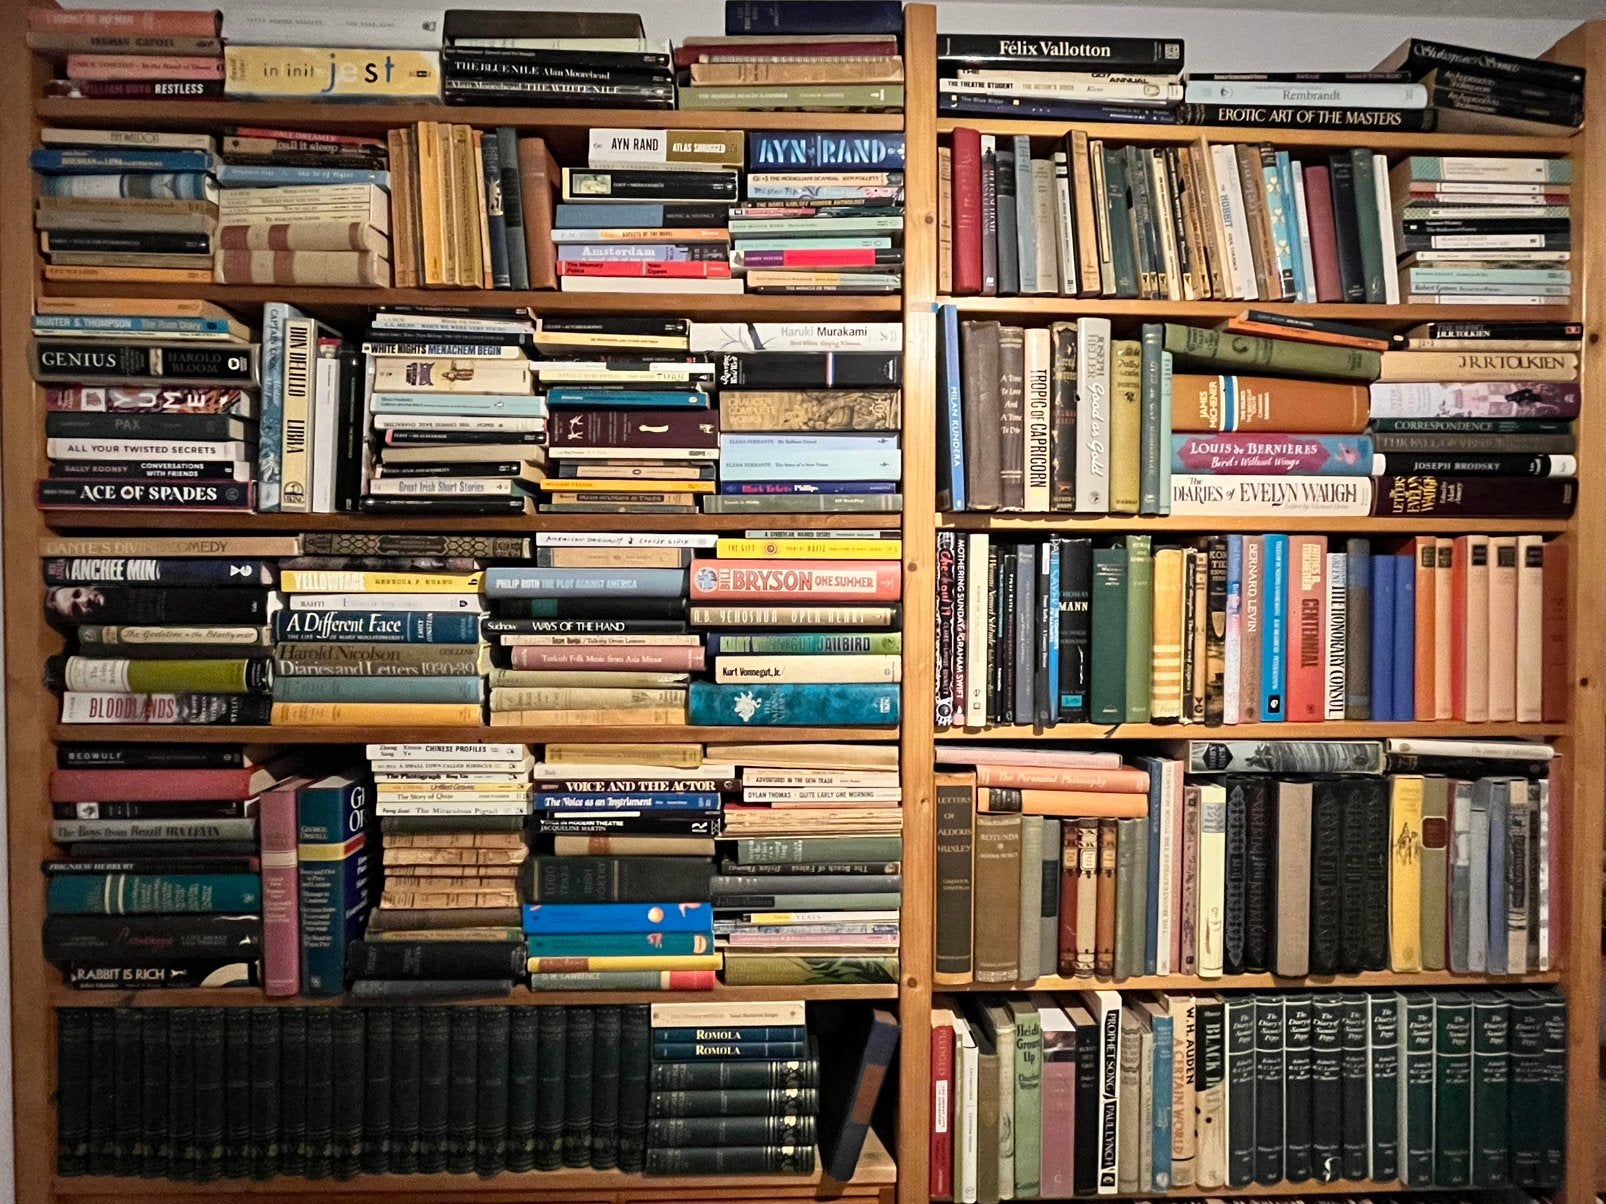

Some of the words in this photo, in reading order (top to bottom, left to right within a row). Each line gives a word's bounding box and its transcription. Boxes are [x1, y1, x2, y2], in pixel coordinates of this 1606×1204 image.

[1000, 40, 1037, 56] Félix
[1041, 41, 1111, 57] Vallotton
[455, 62, 481, 71] THE
[481, 64, 510, 73] BLUE
[512, 66, 539, 75] NILE
[544, 68, 564, 76] Alan
[565, 69, 610, 79] Moorehead
[155, 83, 204, 94] RESTLESS
[1283, 90, 1340, 101] Rembrandt
[1218, 109, 1265, 123] EROTIC
[1270, 110, 1292, 123] ART
[1298, 111, 1315, 123] OF
[1318, 111, 1345, 124] THE
[1347, 112, 1402, 125] MASTERS
[278, 141, 297, 150] call
[300, 142, 307, 150] it
[309, 143, 338, 153] sleep
[612, 138, 629, 150] AYN
[633, 139, 659, 151] RAND
[672, 143, 692, 152] ATLAS
[759, 139, 806, 163] AYN
[822, 140, 886, 163] RAND
[582, 247, 655, 256] Amsterdam
[289, 327, 307, 349] DON
[781, 326, 813, 336] Haruki
[817, 326, 868, 337] Murakami
[168, 351, 221, 363] HAROLD
[371, 344, 396, 354] WHITE
[397, 345, 427, 355] NIGHTS
[428, 345, 476, 355] MENACHEM
[477, 346, 502, 355] BEGIN
[1087, 334, 1098, 380] HELLER
[42, 352, 117, 368] GENIUS
[173, 362, 218, 373] BLOOM
[1499, 356, 1565, 369] TOLKIEN
[288, 353, 307, 397] DELILLO
[1030, 369, 1048, 409] TROPIC
[950, 387, 958, 418] MILAN
[1092, 383, 1105, 425] Good
[1200, 391, 1208, 418] JAMES
[1209, 381, 1217, 428] MICHENER
[114, 419, 140, 430] PAX
[1031, 410, 1046, 421] OF
[1394, 420, 1493, 431] CORRESPONDENCE
[286, 419, 305, 454] LIBRA
[952, 420, 961, 466] KUNDERA
[91, 445, 119, 453] YOUR
[124, 446, 168, 454] TWISTED
[172, 446, 216, 454] SECRETS
[1030, 422, 1047, 488] CAPRICORN
[1190, 442, 1231, 454] LOUIS
[1234, 445, 1245, 454] de
[1087, 440, 1104, 476] Gold
[1414, 462, 1451, 471] JOSEPH
[1454, 462, 1500, 471] BRODSKY
[399, 481, 418, 492] Great
[419, 482, 436, 492] Irish
[438, 482, 457, 492] Short
[459, 482, 484, 492] Stories
[1190, 477, 1202, 485] The
[80, 486, 116, 501] ACE
[121, 486, 145, 501] OF
[149, 487, 218, 503] SPADES
[1174, 486, 1223, 504] DIARIES
[1226, 487, 1236, 499] of
[1240, 482, 1298, 507] EVELYN
[1301, 483, 1357, 503] WAUGH
[71, 559, 125, 580] ANCHEE
[126, 559, 157, 580] MIN
[957, 540, 965, 591] MOTHERING
[1249, 544, 1258, 597] BERNARD
[295, 573, 365, 591] YELLOWFACE
[496, 579, 519, 588] PHILIP
[521, 579, 539, 588] ROTH
[541, 580, 554, 588] THE
[556, 580, 574, 588] PLOT
[575, 580, 604, 588] AGAINST
[606, 580, 637, 588] AMERICA
[719, 568, 731, 590] BILL
[732, 570, 813, 590] BRYSON
[815, 576, 833, 587] ONE
[834, 576, 874, 588] SUMMER
[1331, 586, 1346, 607] THE
[957, 593, 965, 627] SUNDAY
[1059, 602, 1088, 611] MANN
[1248, 599, 1258, 632] LEVIN
[286, 613, 301, 631] A
[304, 612, 363, 638] Different
[369, 614, 401, 631] Face
[532, 622, 557, 631] WAYS
[560, 622, 573, 631] OF
[576, 622, 594, 631] THE
[596, 622, 625, 631] HAND
[1301, 599, 1320, 667] CENTENNIAL
[818, 636, 871, 651] JAILBIRD
[1330, 609, 1345, 668] HONORARY
[279, 645, 332, 661] Harold
[335, 645, 400, 661] Nicolson
[956, 635, 965, 672] GRAHAM
[280, 661, 333, 675] Diaries
[338, 662, 363, 675] and
[366, 662, 418, 675] Letters
[422, 662, 475, 675] 1930-39
[955, 674, 964, 699] SWIFT
[1328, 670, 1344, 716] CONSUL
[90, 698, 175, 718] BLOODLANDS
[565, 782, 605, 791] VOICE
[607, 782, 635, 791] AND
[638, 782, 669, 791] THE
[671, 781, 716, 791] ACTOR
[544, 798, 560, 806] The
[563, 797, 583, 806] Voice
[606, 797, 652, 808] Instrument
[938, 828, 972, 836] ALDOUS
[981, 833, 1019, 842] ROTUNDA
[78, 969, 118, 980] RABBIT
[122, 969, 131, 980] IS
[135, 969, 165, 980] RICH
[1017, 1024, 1039, 1037] Heidi
[1186, 1007, 1195, 1037] W.H.
[1106, 1013, 1117, 1057] PROPHET
[1174, 1038, 1183, 1046] A
[1205, 1024, 1221, 1071] BLACK
[1024, 1052, 1035, 1064] Up
[1186, 1040, 1194, 1085] AUDEN
[1105, 1061, 1116, 1091] SONG
[1173, 1059, 1184, 1105] CERTAIN
[1104, 1105, 1115, 1130] PAUL
[1173, 1108, 1184, 1154] WORLD
[1103, 1131, 1114, 1166] LYNCH
